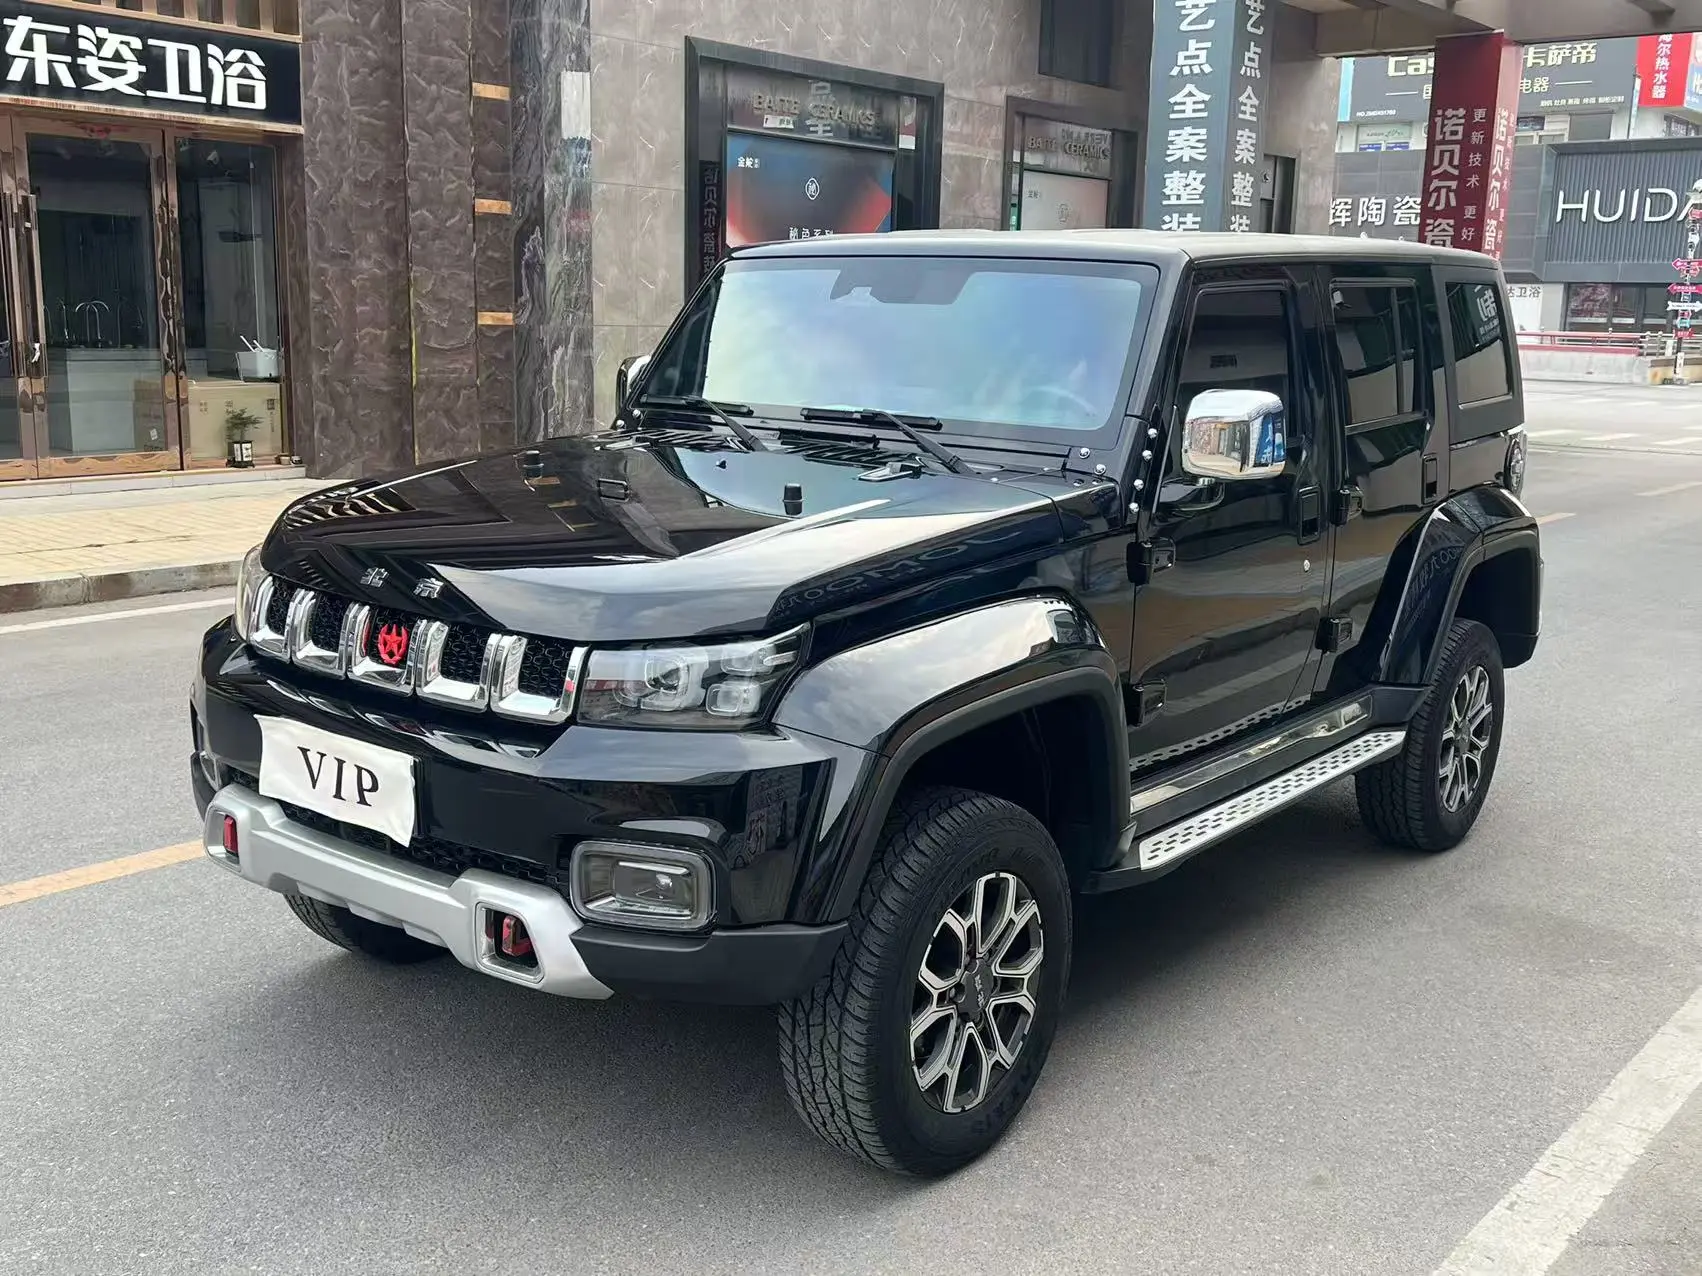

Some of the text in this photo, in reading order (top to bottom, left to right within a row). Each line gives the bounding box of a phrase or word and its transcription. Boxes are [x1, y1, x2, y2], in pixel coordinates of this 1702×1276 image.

[3, 15, 267, 110] 东姿卫浴
[1523, 42, 1598, 68] 卡萨帝
[298, 745, 380, 807] VIP
